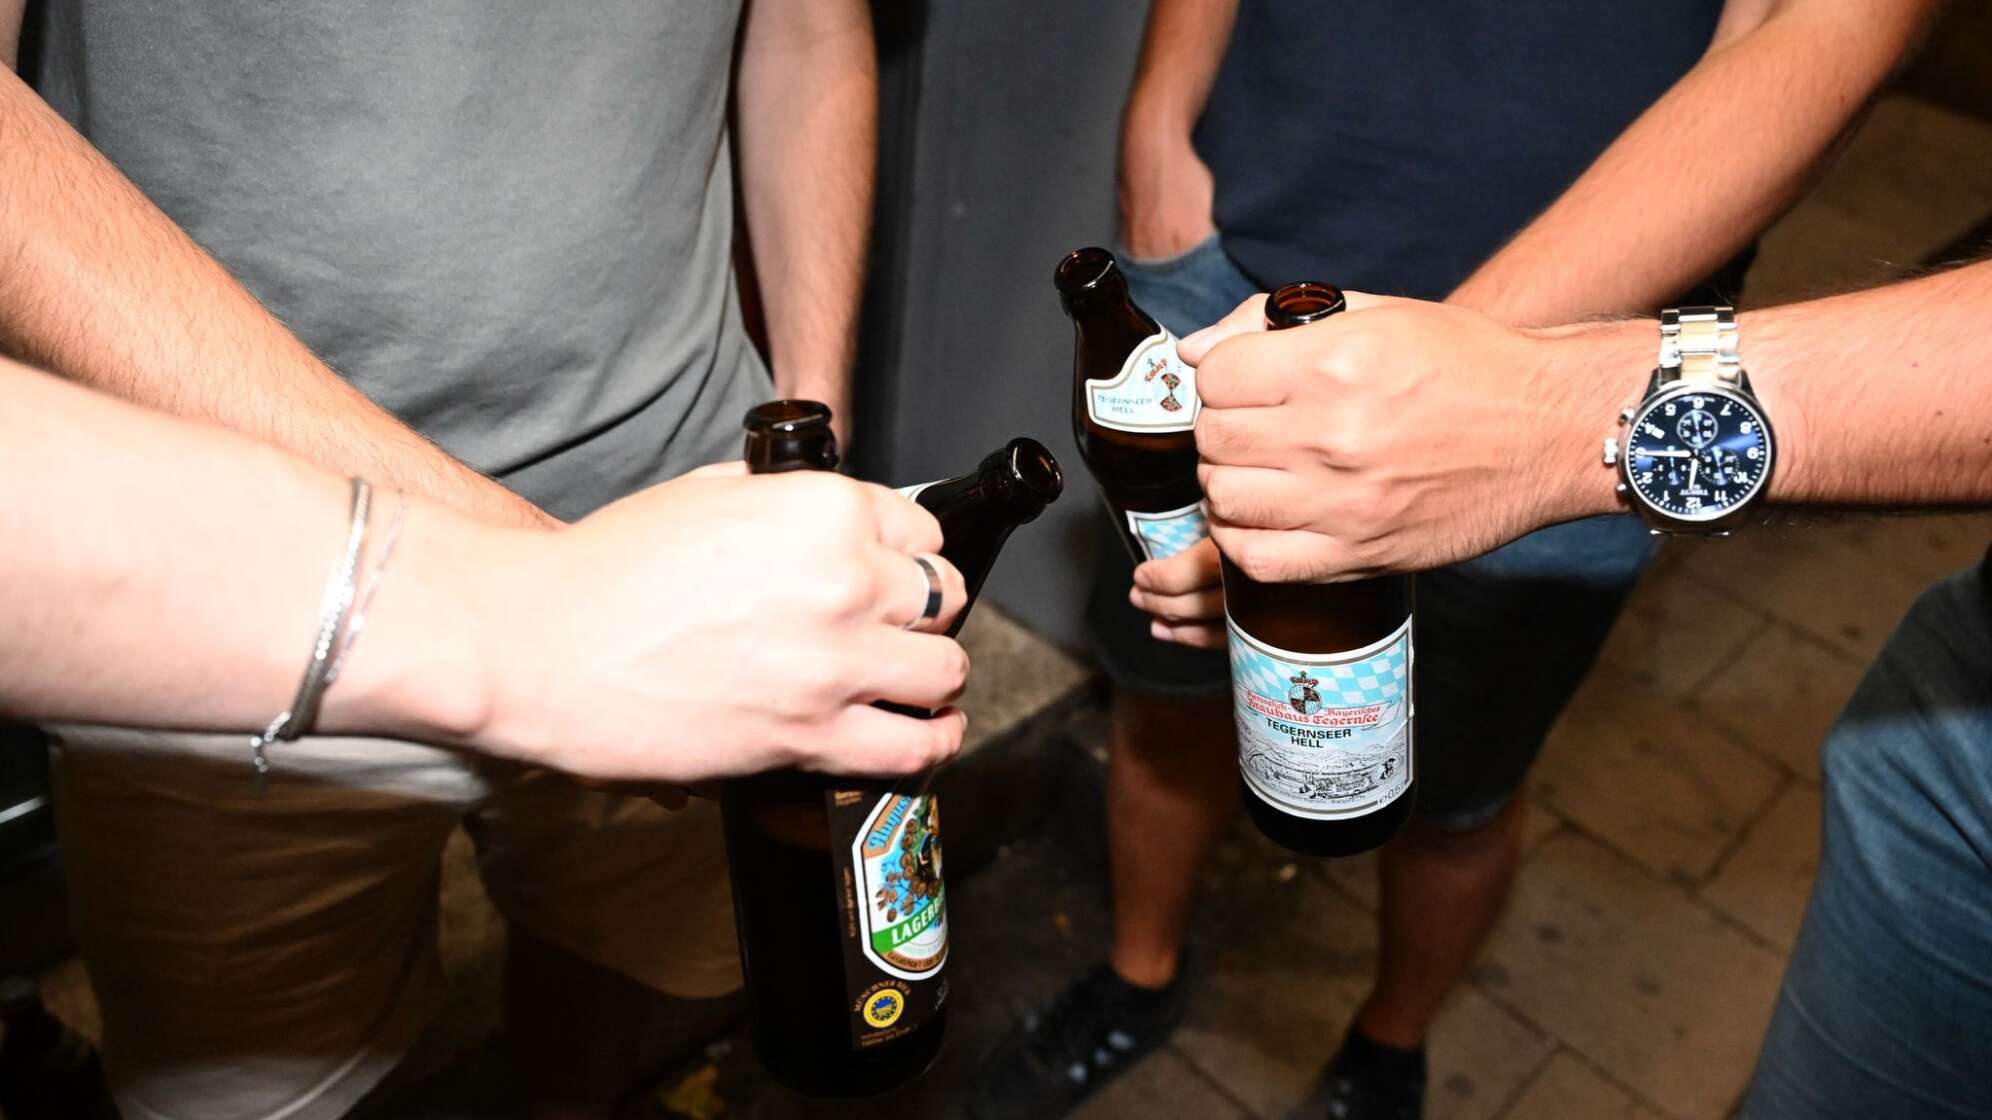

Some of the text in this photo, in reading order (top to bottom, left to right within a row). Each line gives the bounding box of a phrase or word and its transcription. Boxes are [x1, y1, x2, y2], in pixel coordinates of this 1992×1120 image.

[1112, 406, 1135, 414] HELL
[1665, 403, 1677, 416] 5
[1720, 403, 1732, 416] 7
[1747, 447, 1759, 460] 9
[1642, 472, 1653, 484] 2
[1714, 490, 1728, 502] 11
[1686, 497, 1703, 508] 12
[1265, 717, 1352, 740] TEGERNSEER
[1291, 736, 1324, 748] HELL
